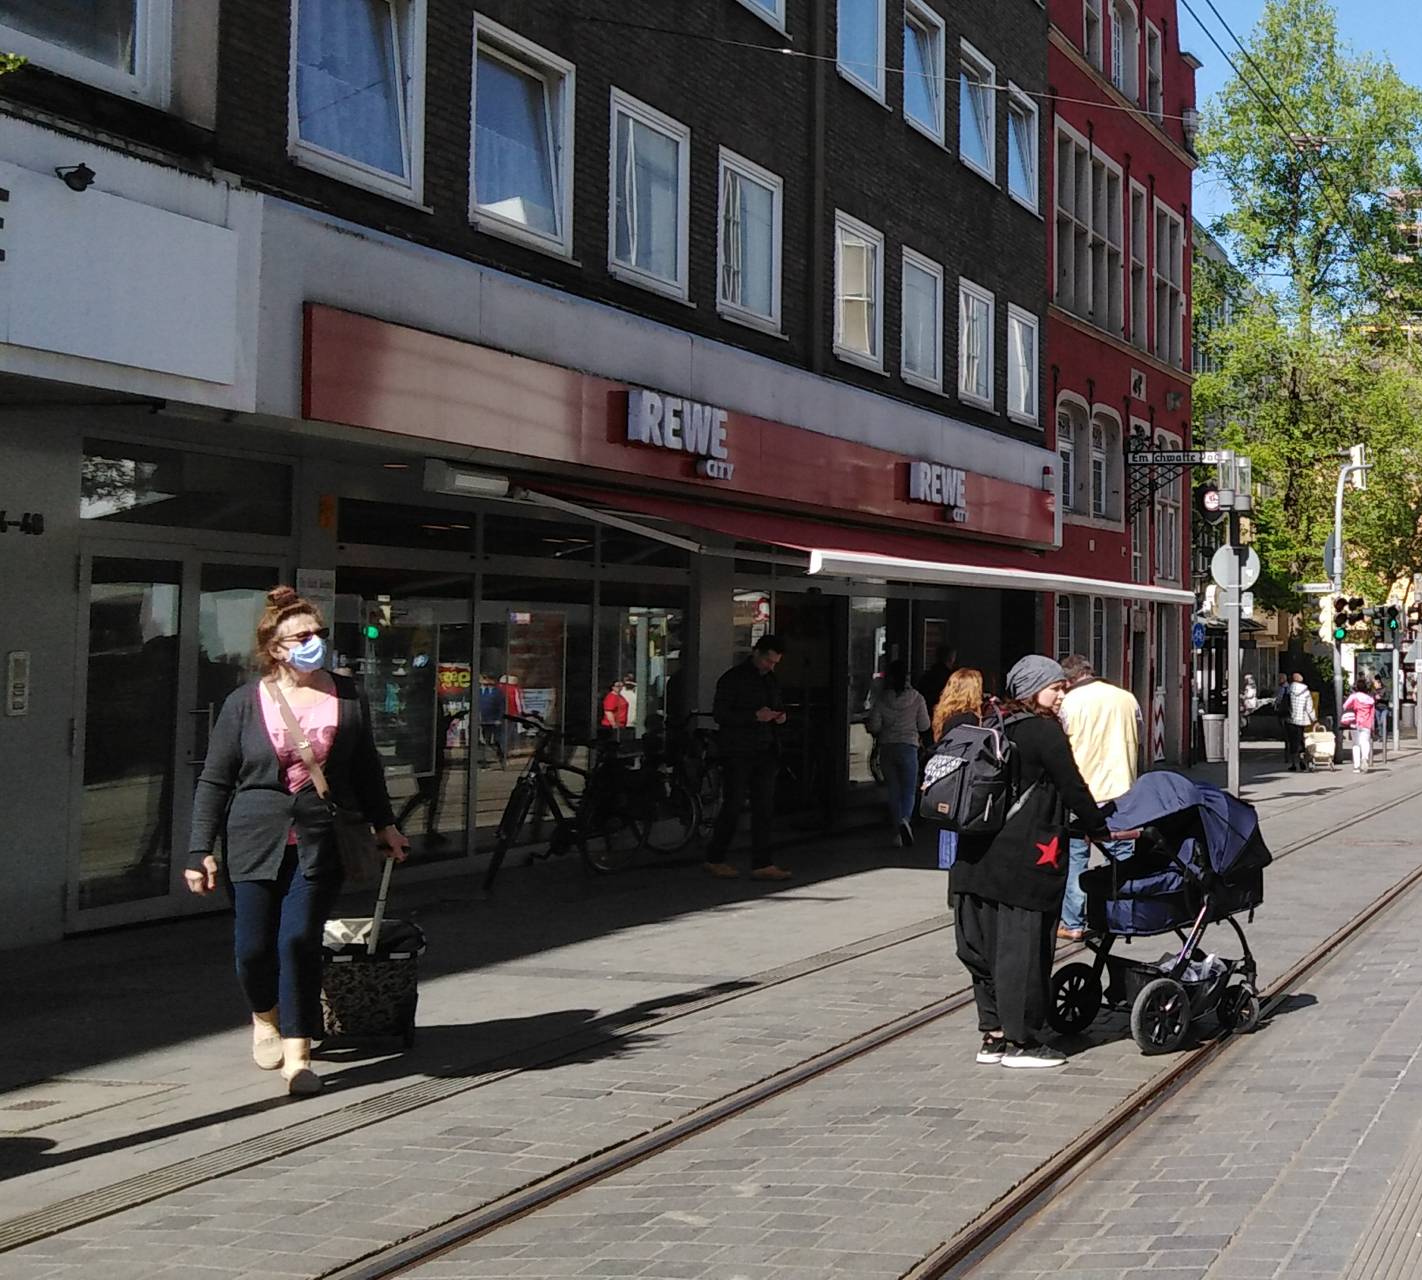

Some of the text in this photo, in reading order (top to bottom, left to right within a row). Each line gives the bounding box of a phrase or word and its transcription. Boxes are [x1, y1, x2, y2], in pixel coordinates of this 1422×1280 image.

[630, 389, 728, 460] REWE
[705, 458, 735, 480] CITY
[912, 461, 967, 508] REWE
